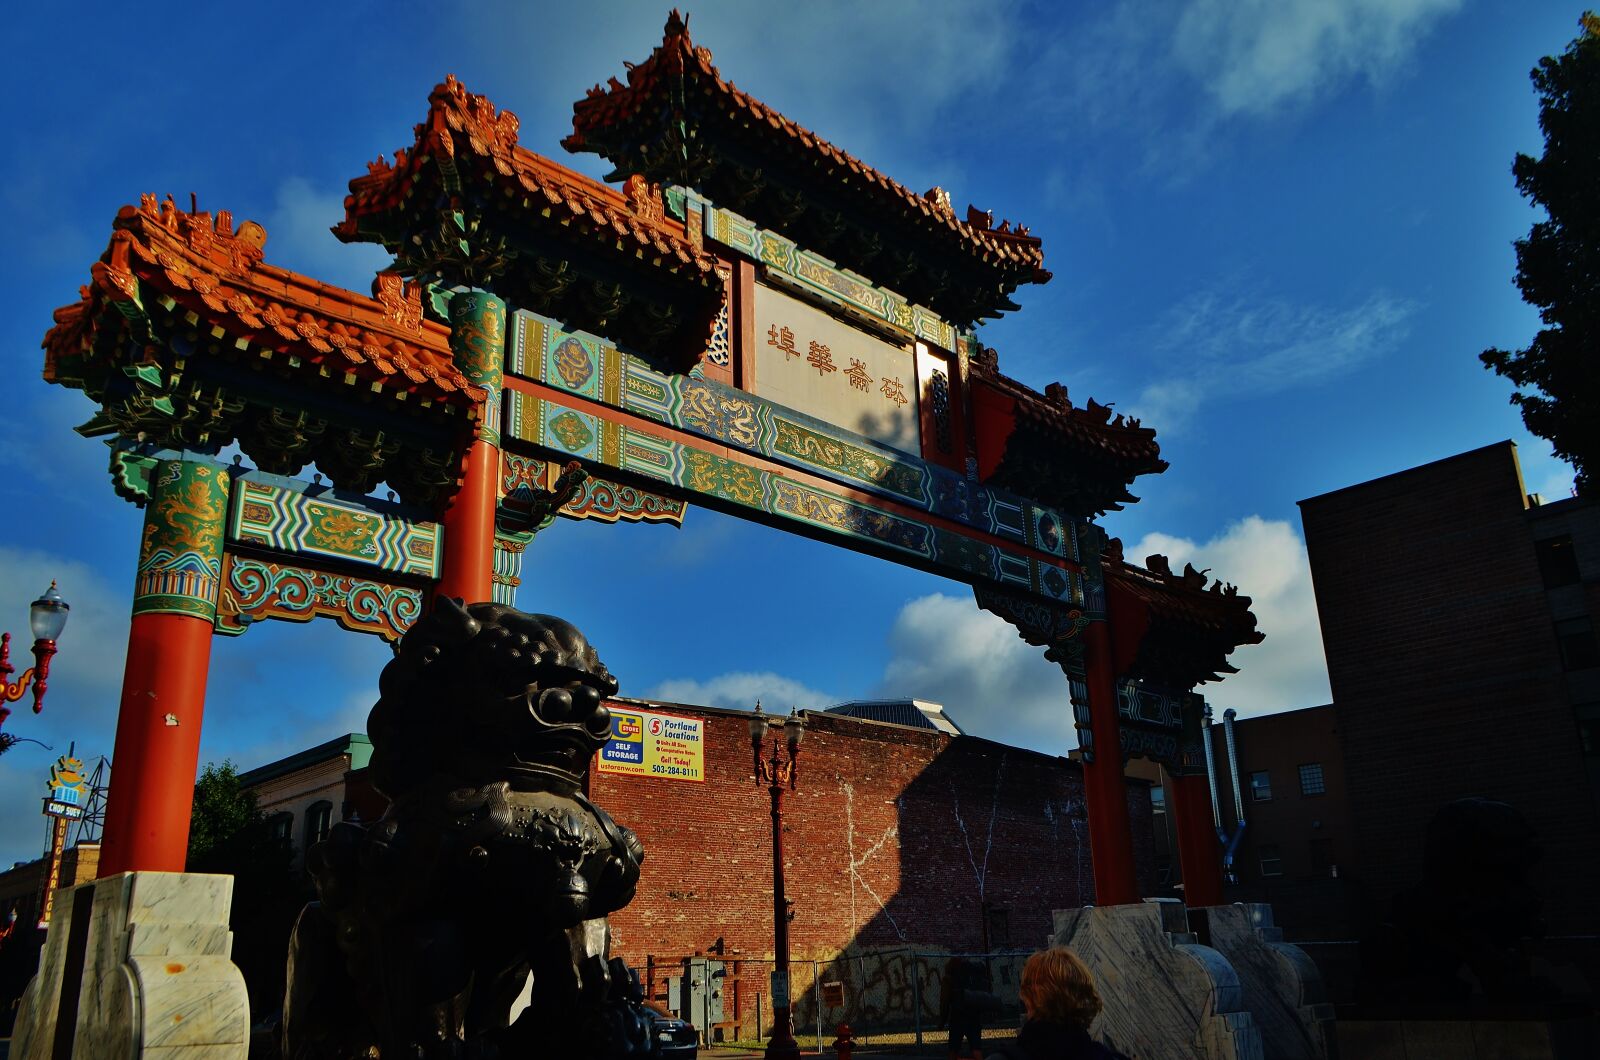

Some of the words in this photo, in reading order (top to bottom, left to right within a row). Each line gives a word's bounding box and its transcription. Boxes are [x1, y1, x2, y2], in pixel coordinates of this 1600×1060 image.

[611, 716, 636, 738] U
[622, 725, 640, 733] STORE
[652, 720, 660, 734] 5
[664, 719, 698, 732] Portland
[664, 730, 699, 742] Locations
[615, 742, 631, 750] SELF
[607, 750, 639, 760] STORAGE
[600, 763, 645, 774] ustorenw.com
[660, 756, 672, 764] Call
[674, 757, 691, 768] Today!
[652, 764, 698, 778] 503-284-8111
[48, 802, 65, 814] CHOP
[65, 806, 81, 818] SUEY
[56, 817, 67, 856] HUNG
[51, 859, 60, 889] FAR
